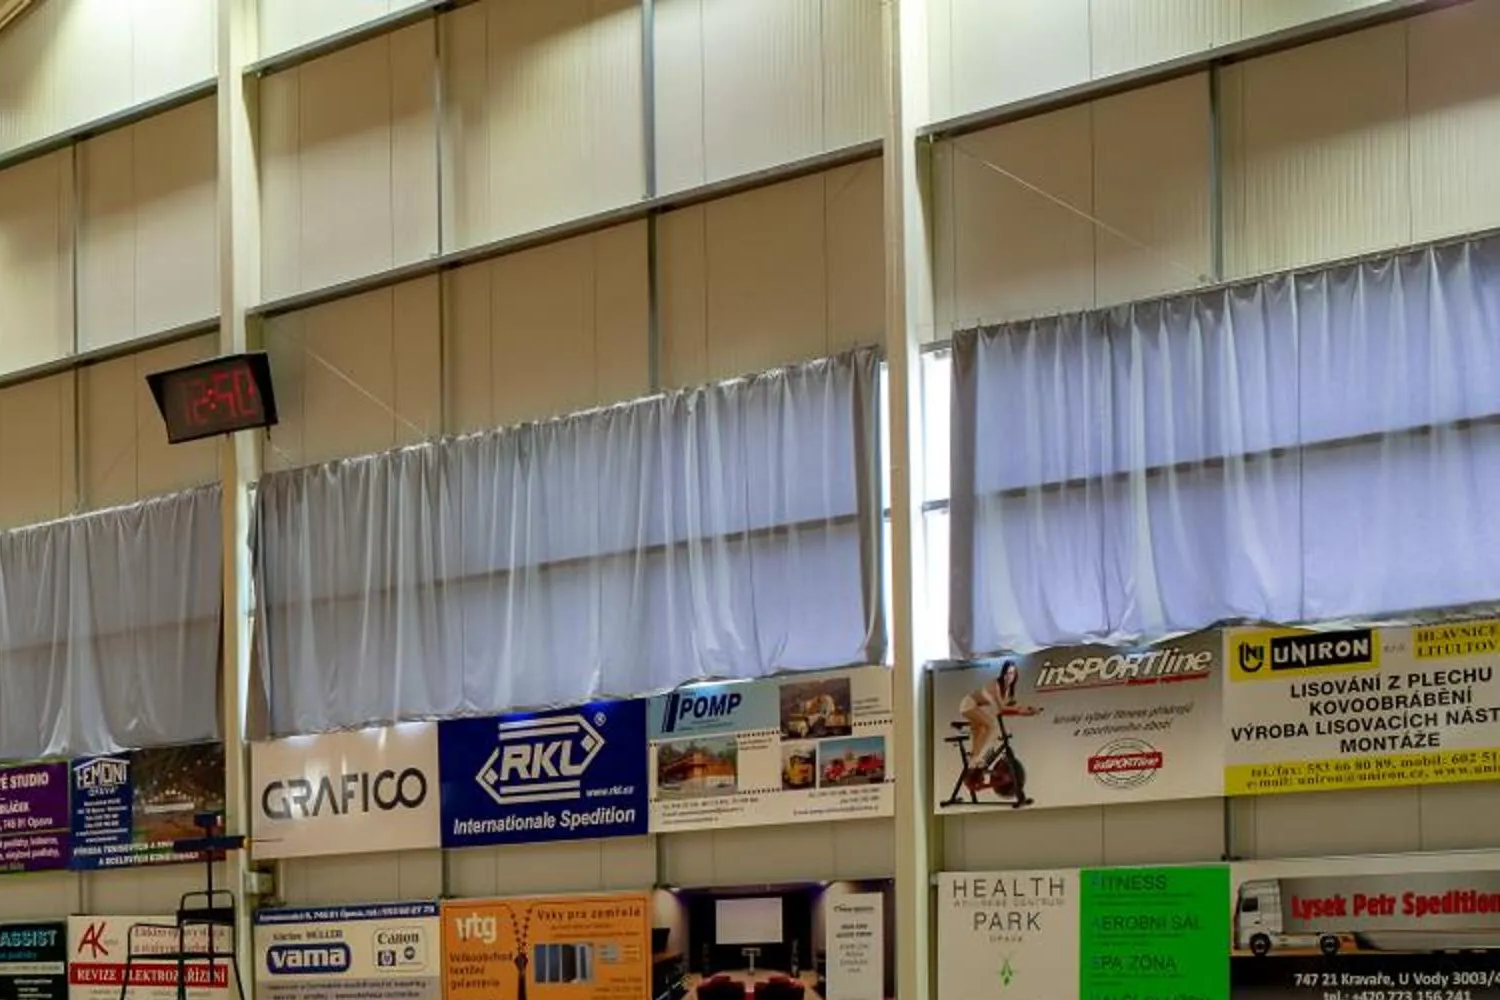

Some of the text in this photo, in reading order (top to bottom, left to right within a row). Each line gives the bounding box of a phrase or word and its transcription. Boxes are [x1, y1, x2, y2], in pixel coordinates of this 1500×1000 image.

[1274, 637, 1369, 668] UNIRON
[1291, 667, 1492, 699] LISOVÁNÍ Z PLECHU
[678, 692, 743, 720] POMP
[1309, 687, 1473, 717] KOVOOBRÁBĚNÍ
[1231, 723, 1309, 742] VÝROBA
[1316, 713, 1438, 736] LISOVACÍCH
[1340, 732, 1441, 754] MONTÁŽE
[500, 740, 584, 781] RKL
[10, 771, 49, 789] STUDIO
[261, 767, 428, 821] GRAFICO
[453, 811, 556, 836] Internationale
[560, 806, 636, 829] Spedition
[952, 877, 1066, 899] HEALTH
[1290, 895, 1348, 921] Lysek
[1353, 893, 1397, 916] Petr
[972, 911, 1042, 932] PARK
[377, 931, 420, 945] Canon
[270, 948, 347, 969] vama
[77, 968, 117, 982] REVIZE
[1294, 975, 1319, 986] 747
[1322, 974, 1338, 986] 21
[1399, 974, 1409, 985] U
[1412, 973, 1449, 987] Vody
